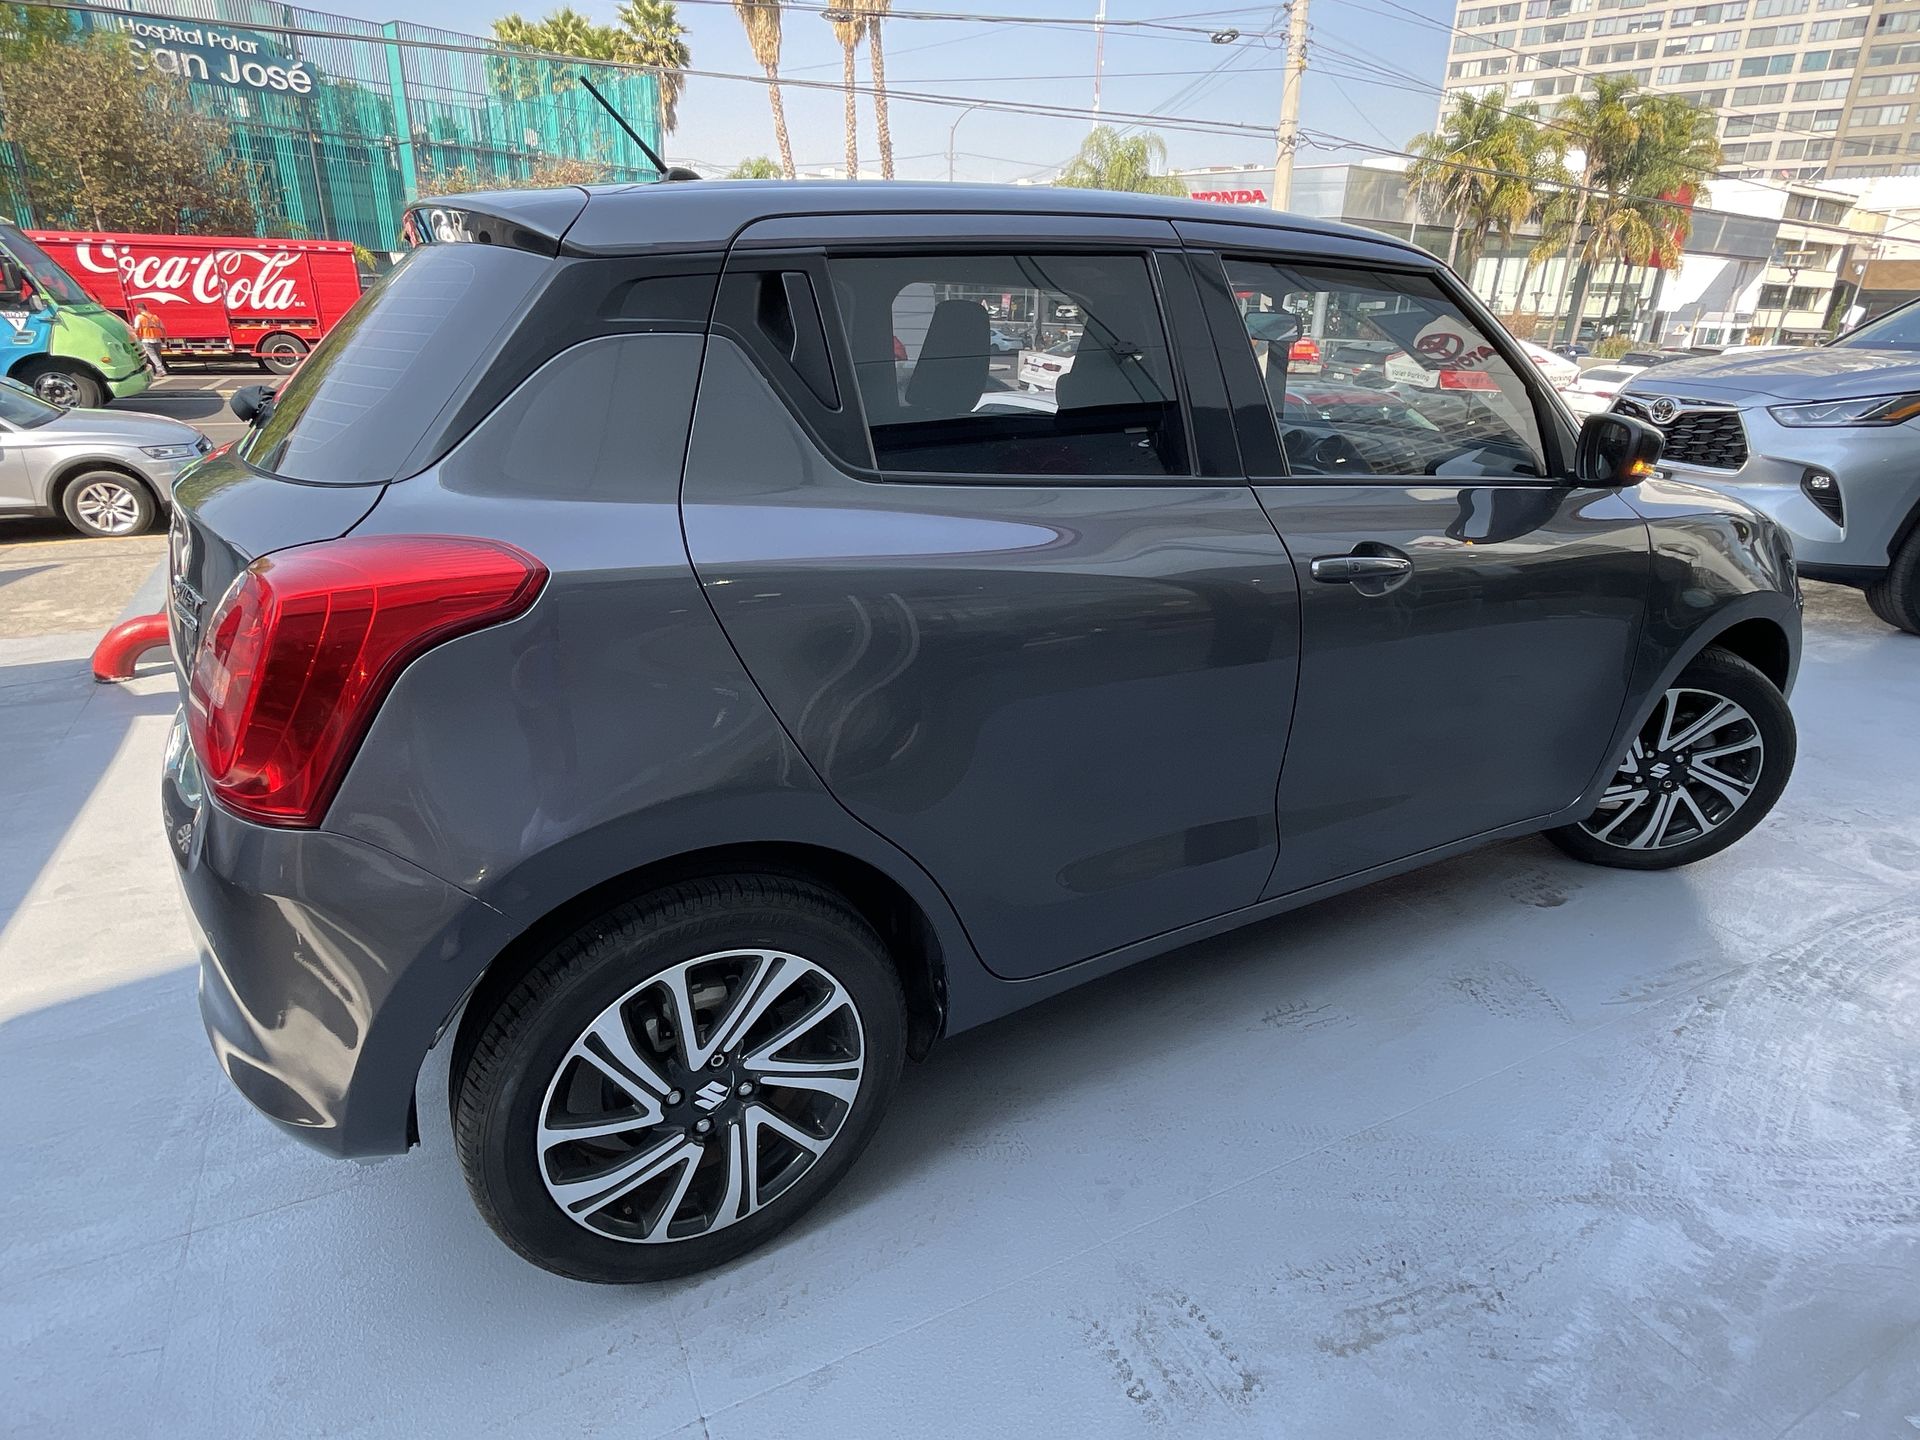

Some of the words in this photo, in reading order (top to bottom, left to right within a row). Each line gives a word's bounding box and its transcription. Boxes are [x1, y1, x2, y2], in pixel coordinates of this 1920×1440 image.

[118, 16, 204, 46] Hospital
[207, 31, 259, 55] Polar
[127, 38, 210, 80] San
[220, 53, 312, 94] José
[76, 244, 303, 311] Coca-Cola
